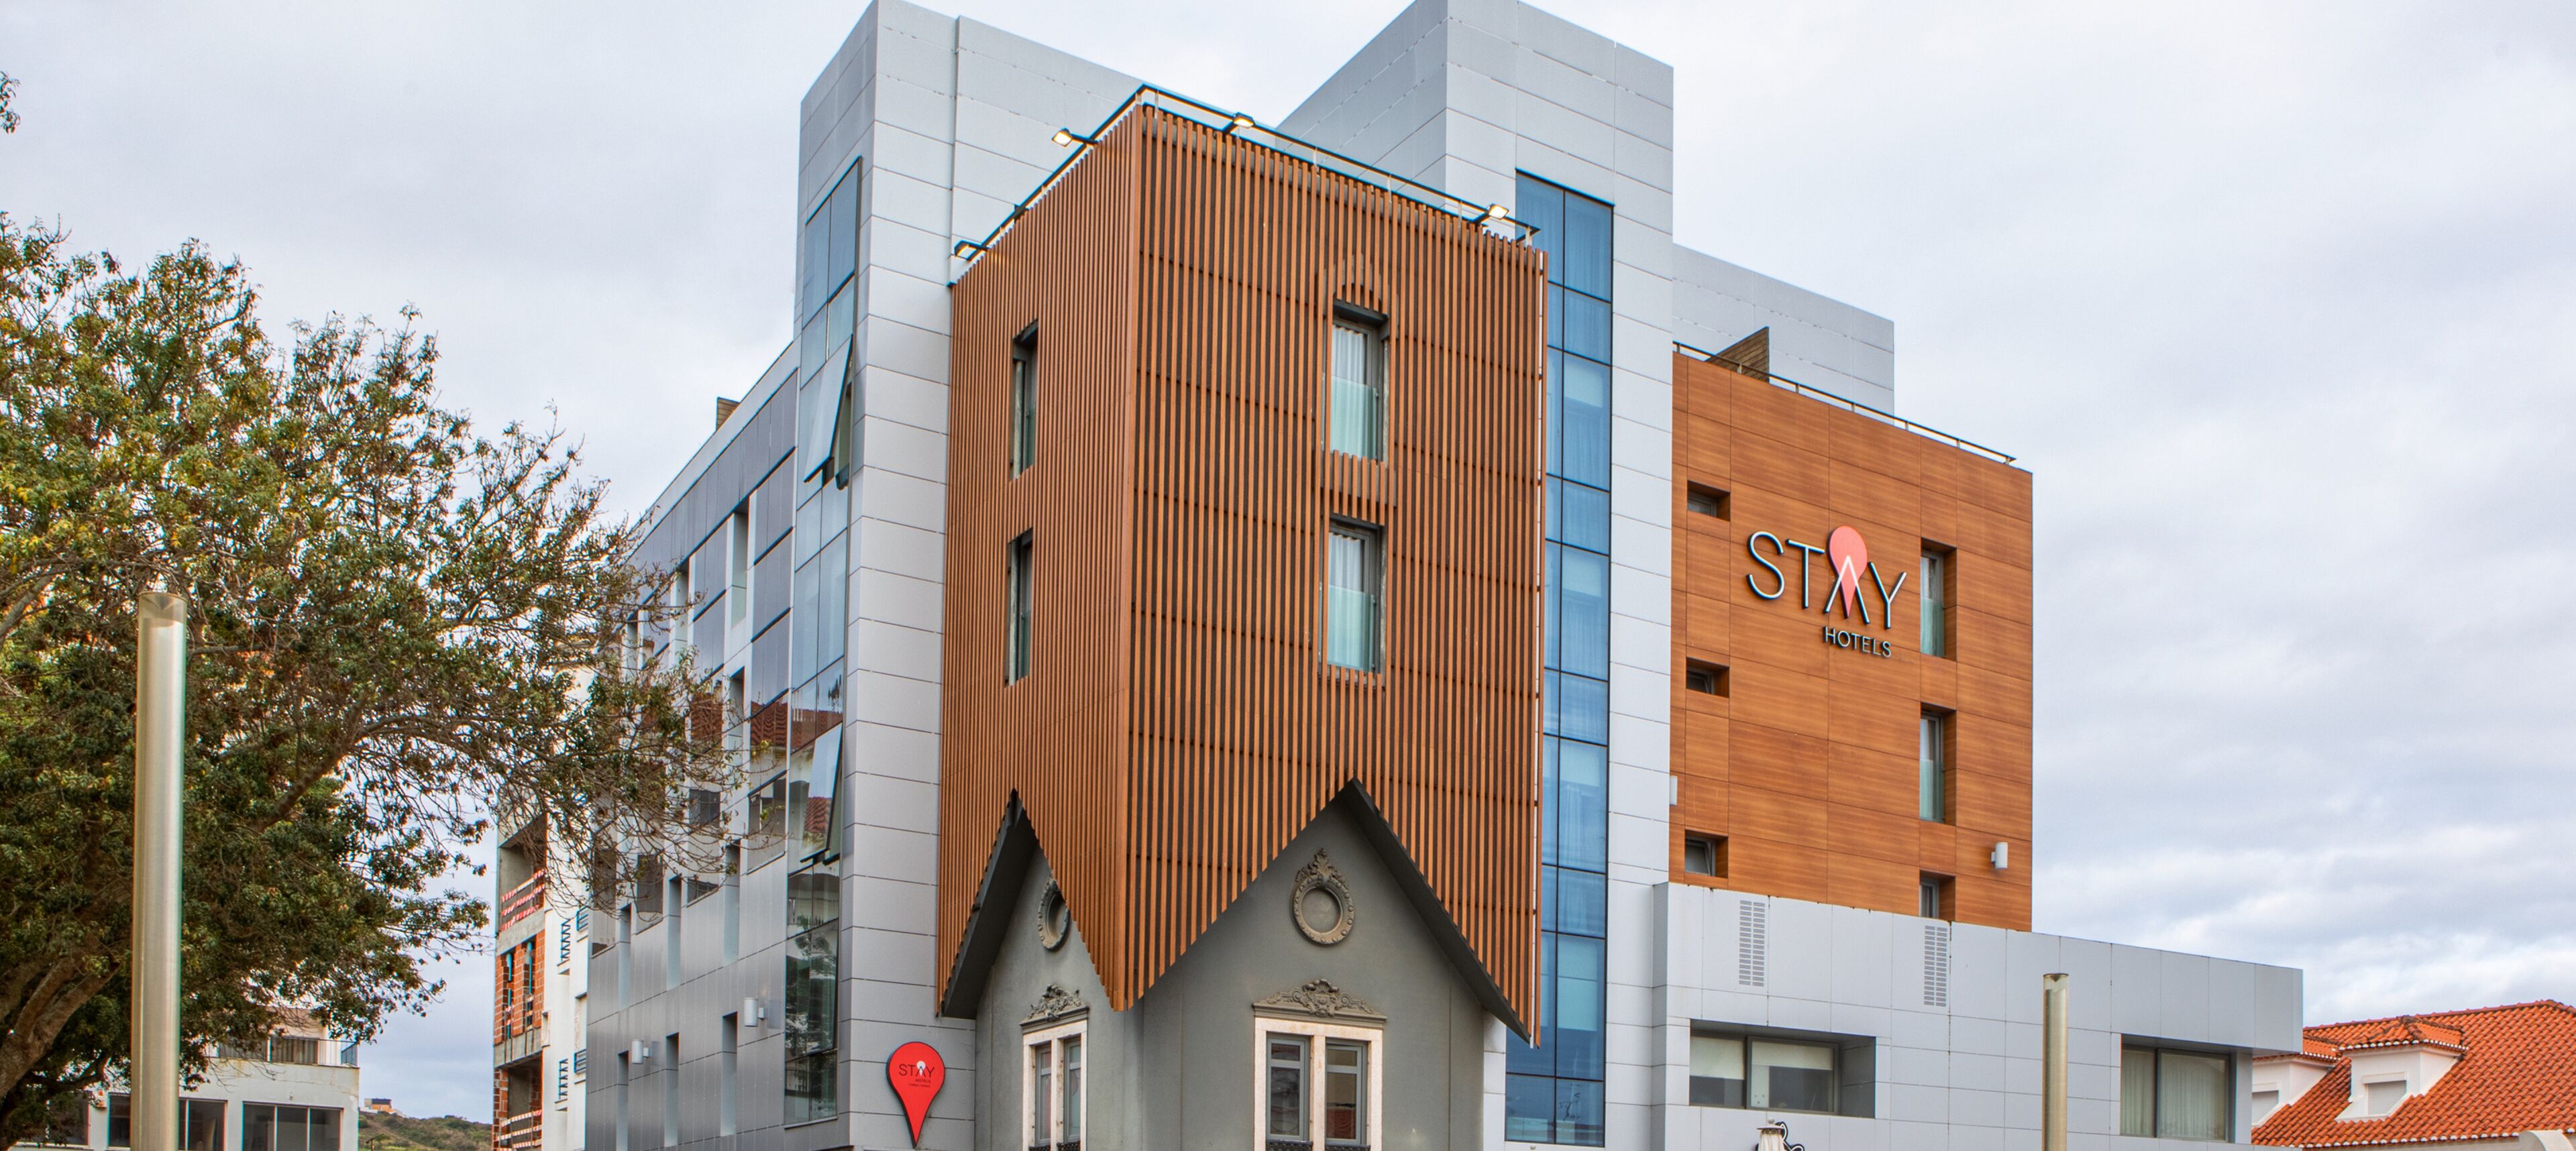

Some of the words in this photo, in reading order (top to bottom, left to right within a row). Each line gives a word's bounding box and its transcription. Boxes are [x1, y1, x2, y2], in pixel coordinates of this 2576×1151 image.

[1746, 529, 1907, 629] STAY
[1823, 625, 1892, 658] HOTELS
[899, 1062, 935, 1078] STAY
